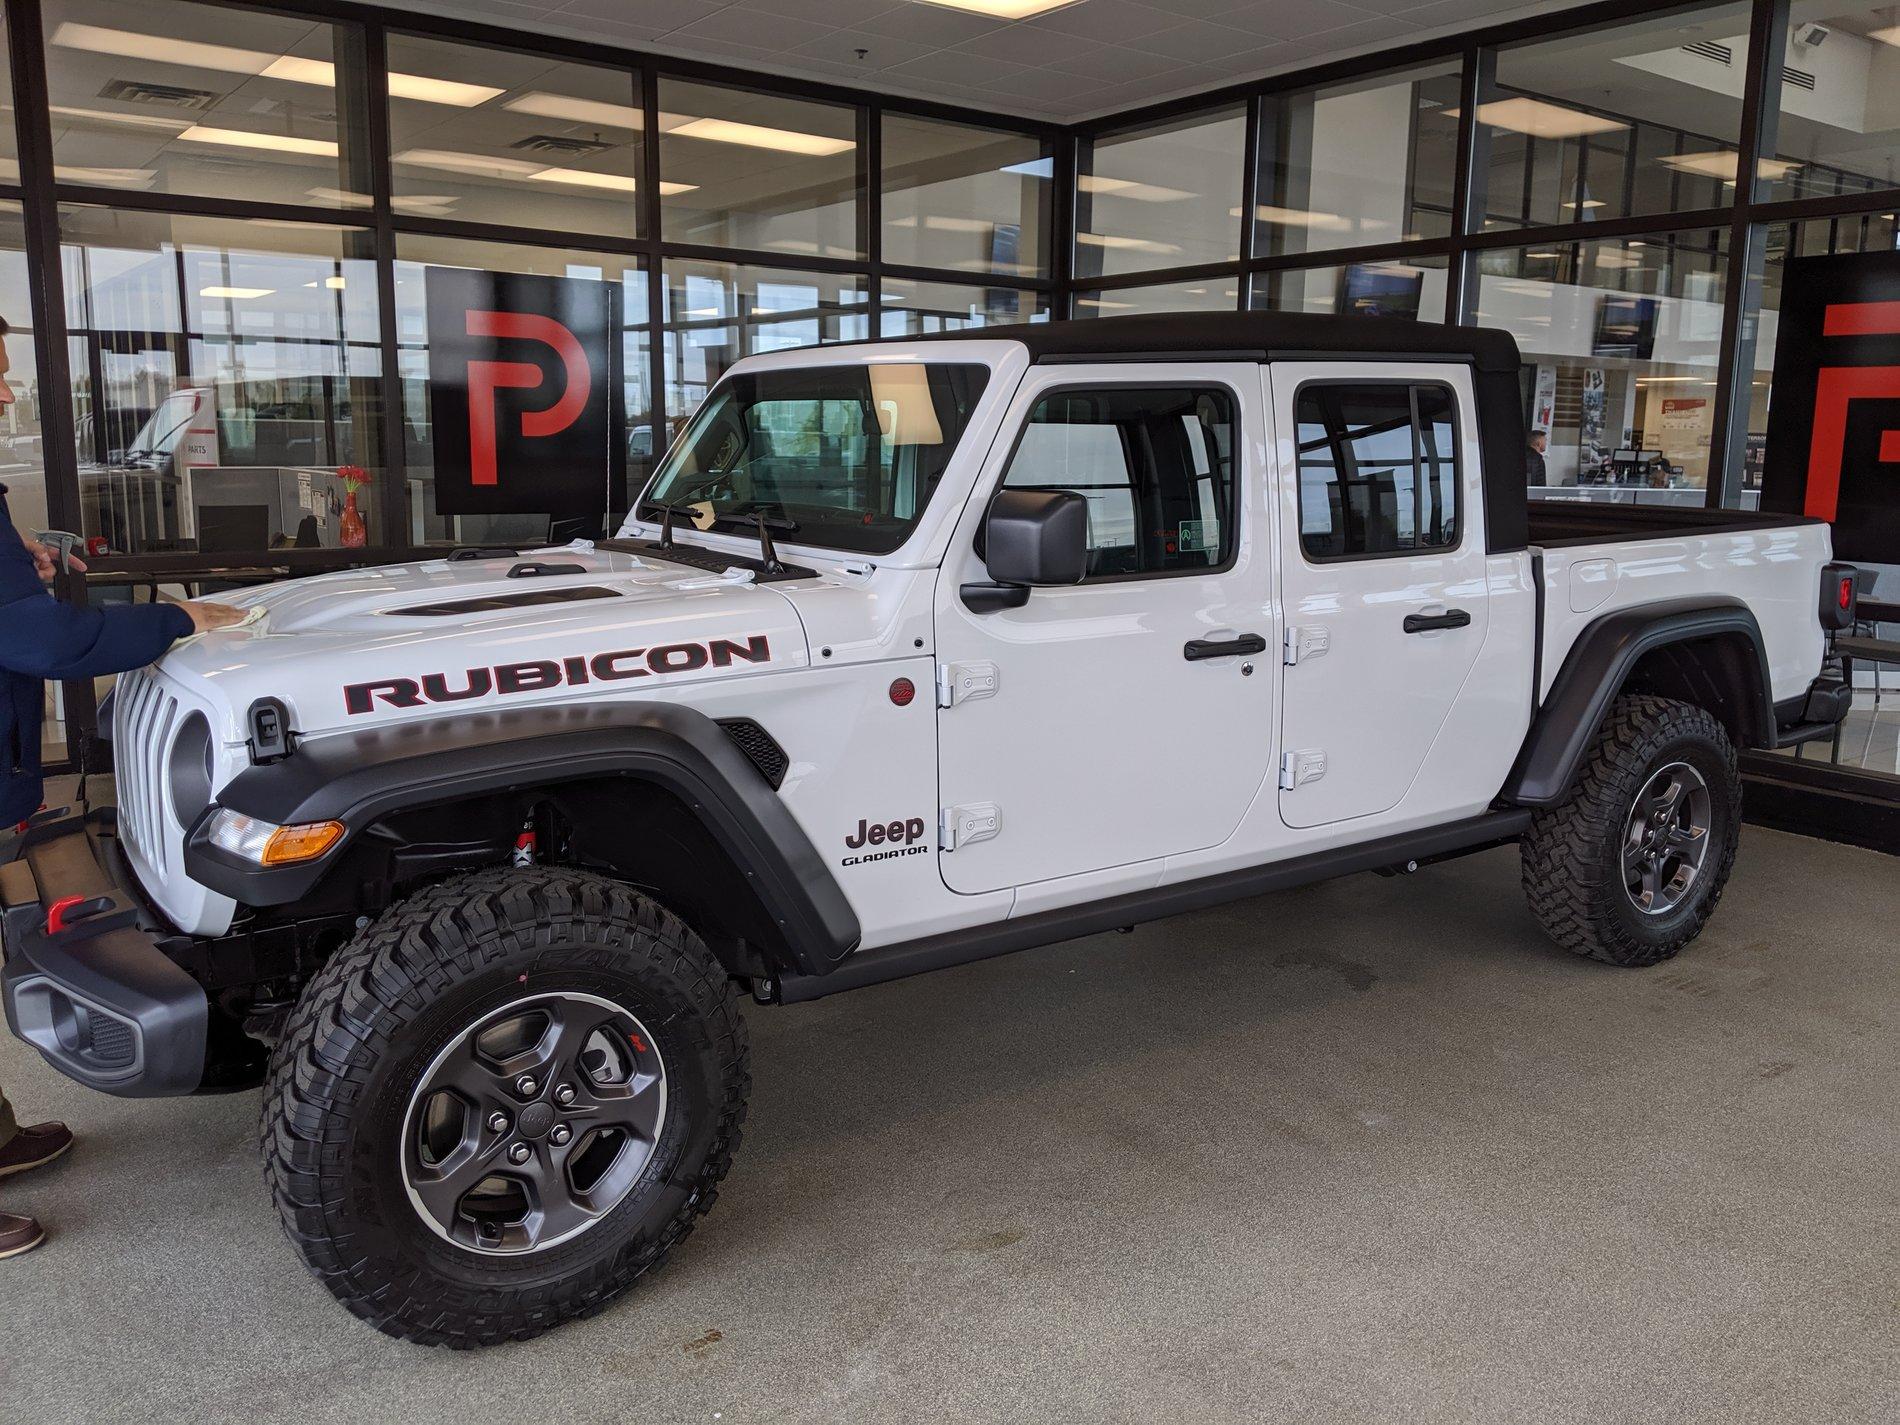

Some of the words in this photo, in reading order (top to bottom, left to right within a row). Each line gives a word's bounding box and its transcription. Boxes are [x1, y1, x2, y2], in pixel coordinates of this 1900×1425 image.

[466, 309, 592, 485] P
[343, 635, 771, 715] RUBICON
[841, 845, 929, 867] GLADIATOR
[845, 817, 925, 850] Jeep
